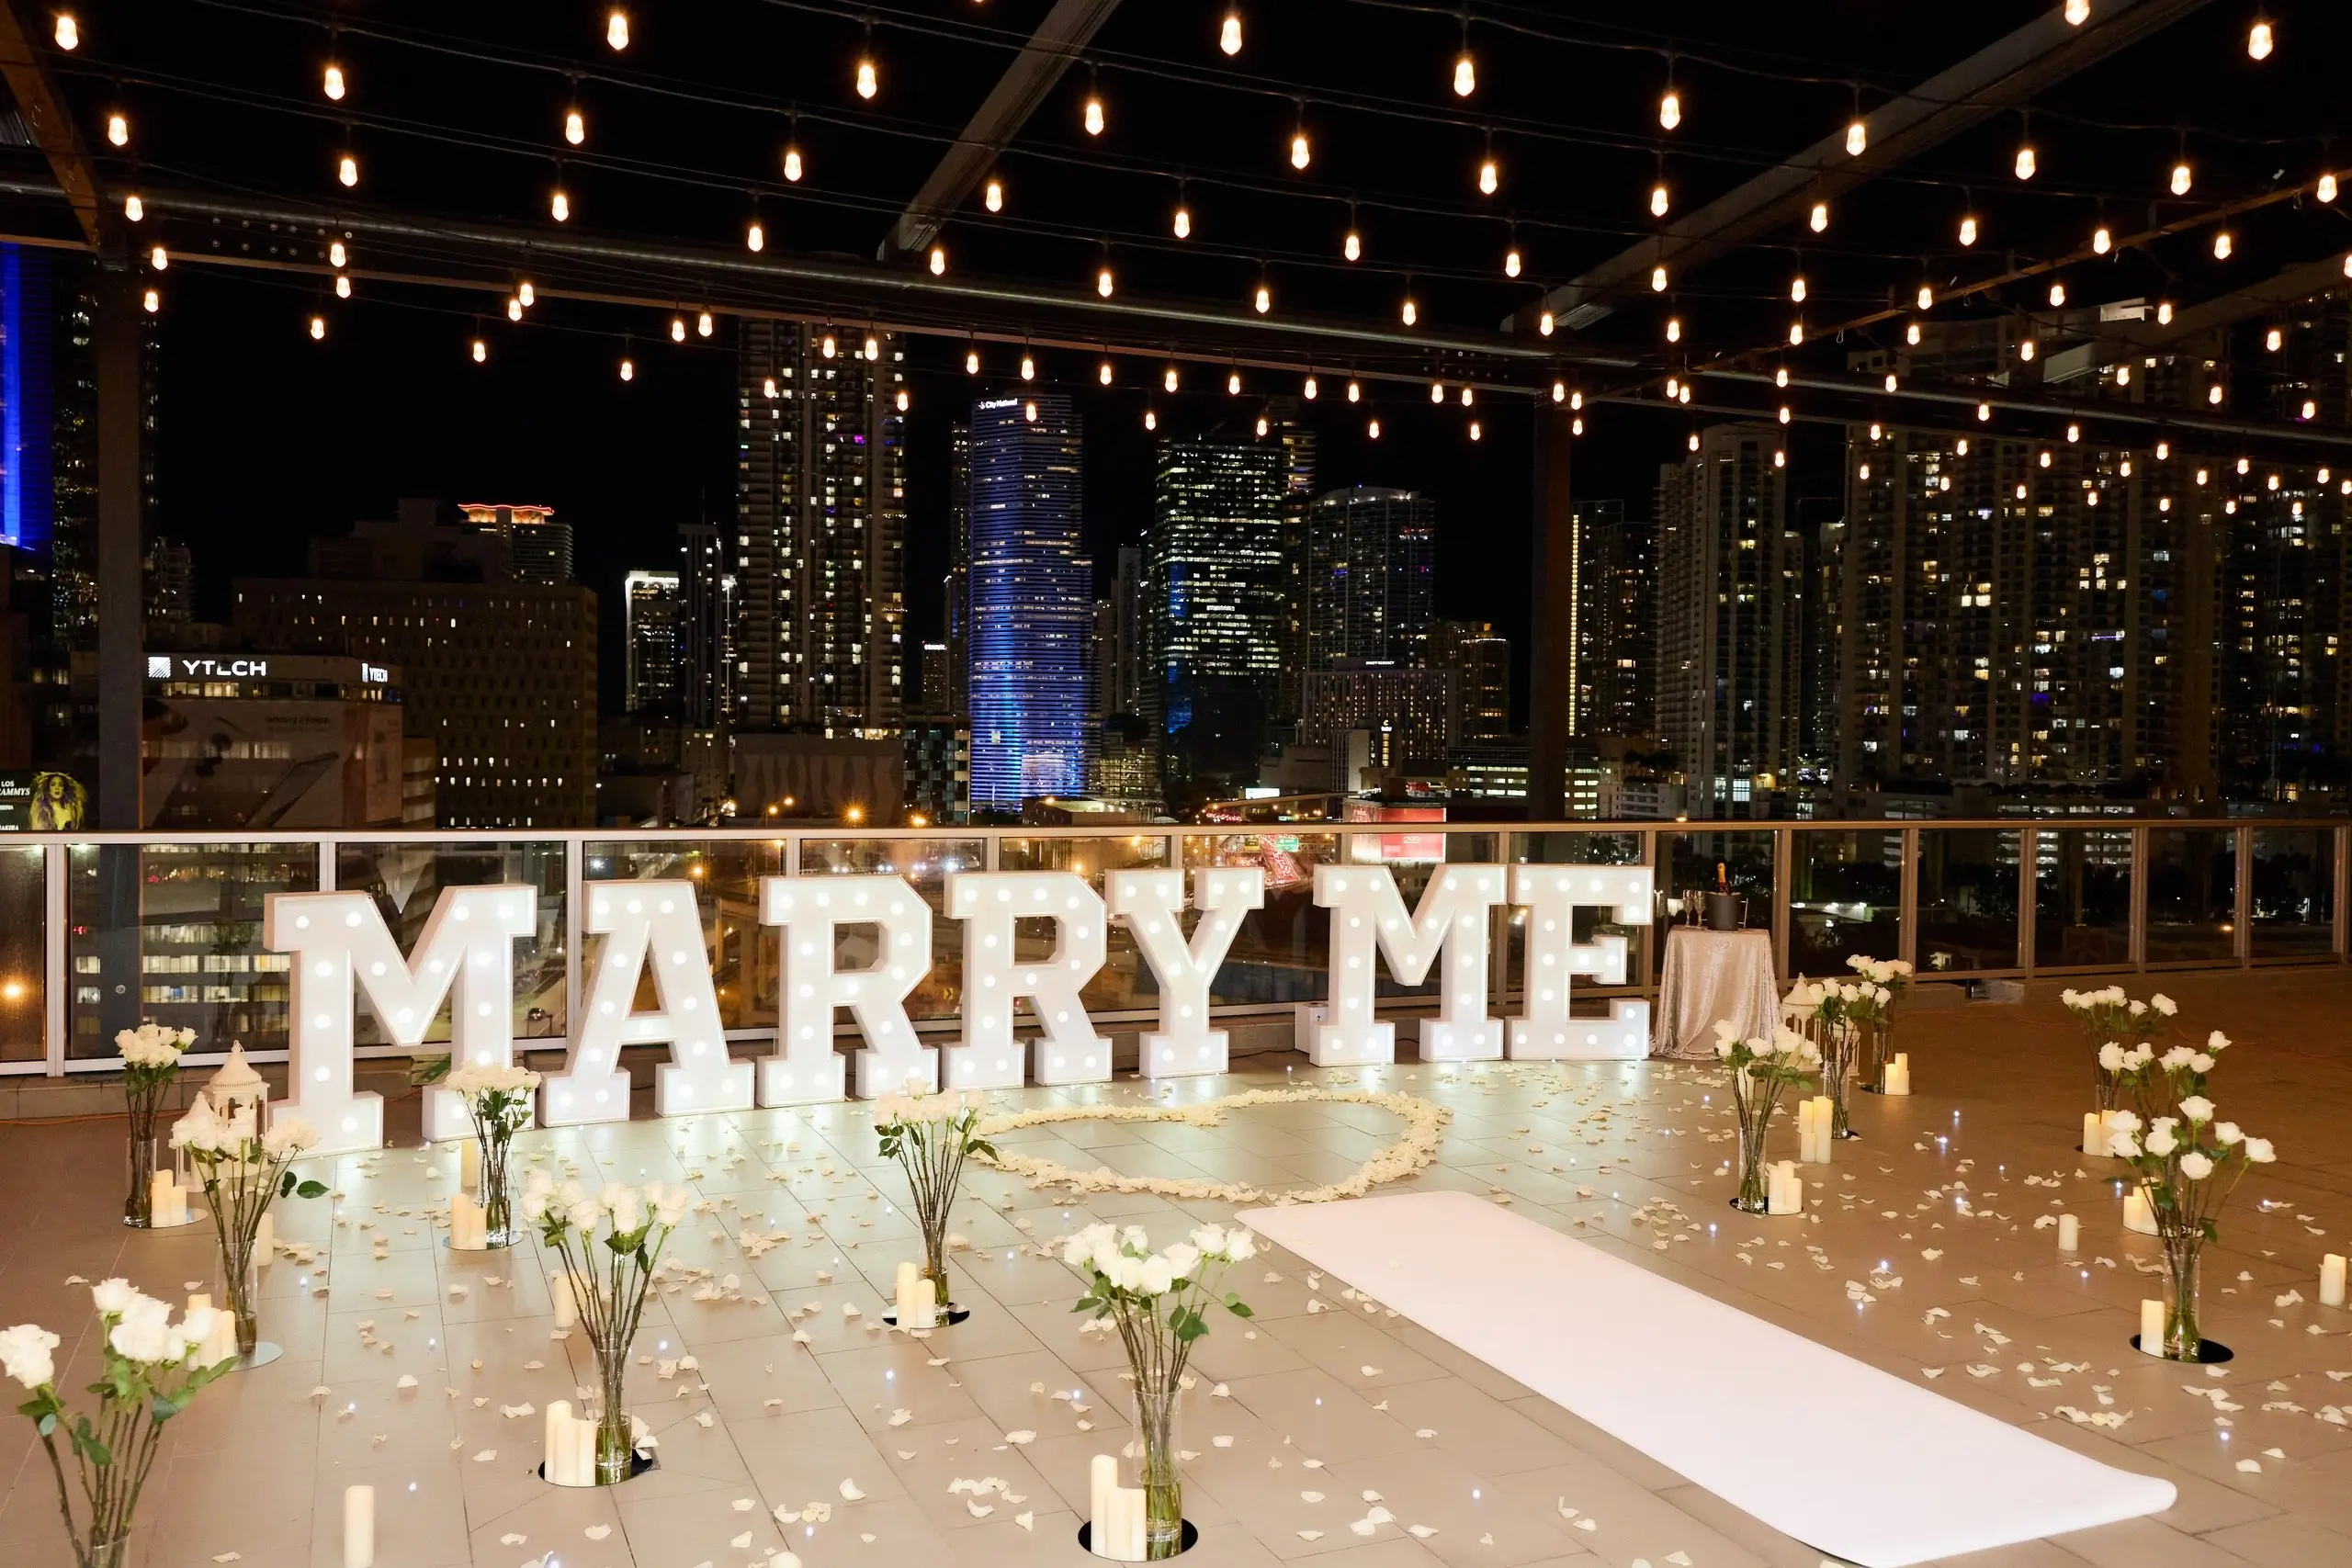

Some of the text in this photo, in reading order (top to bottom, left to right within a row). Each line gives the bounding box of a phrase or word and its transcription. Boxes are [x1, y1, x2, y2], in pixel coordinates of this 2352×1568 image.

[985, 400, 996, 409] City
[368, 667, 388, 682] YTECH
[263, 863, 1654, 1159] MARRY ME
